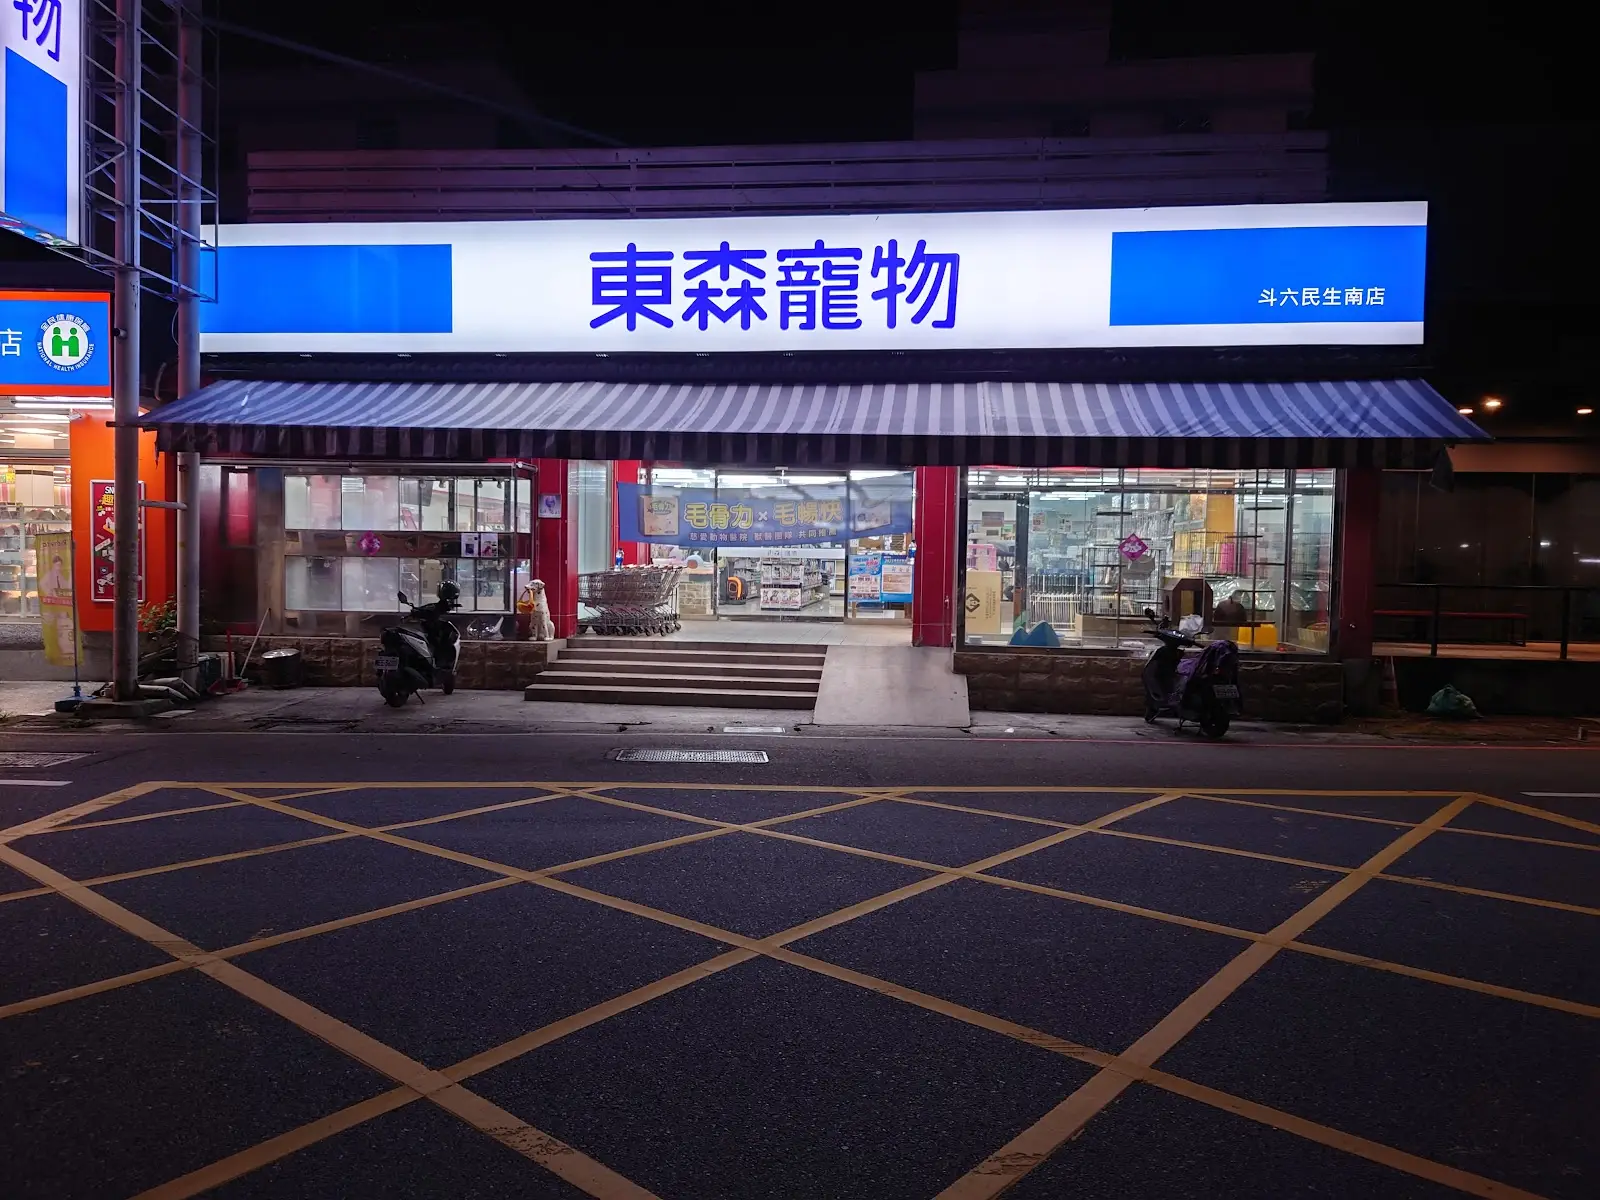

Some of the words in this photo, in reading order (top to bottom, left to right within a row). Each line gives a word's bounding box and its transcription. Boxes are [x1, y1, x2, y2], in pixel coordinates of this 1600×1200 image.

[589, 238, 961, 332] 東森寵物
[1257, 286, 1386, 307] 斗六民生南店
[684, 502, 753, 529] 毛骨力
